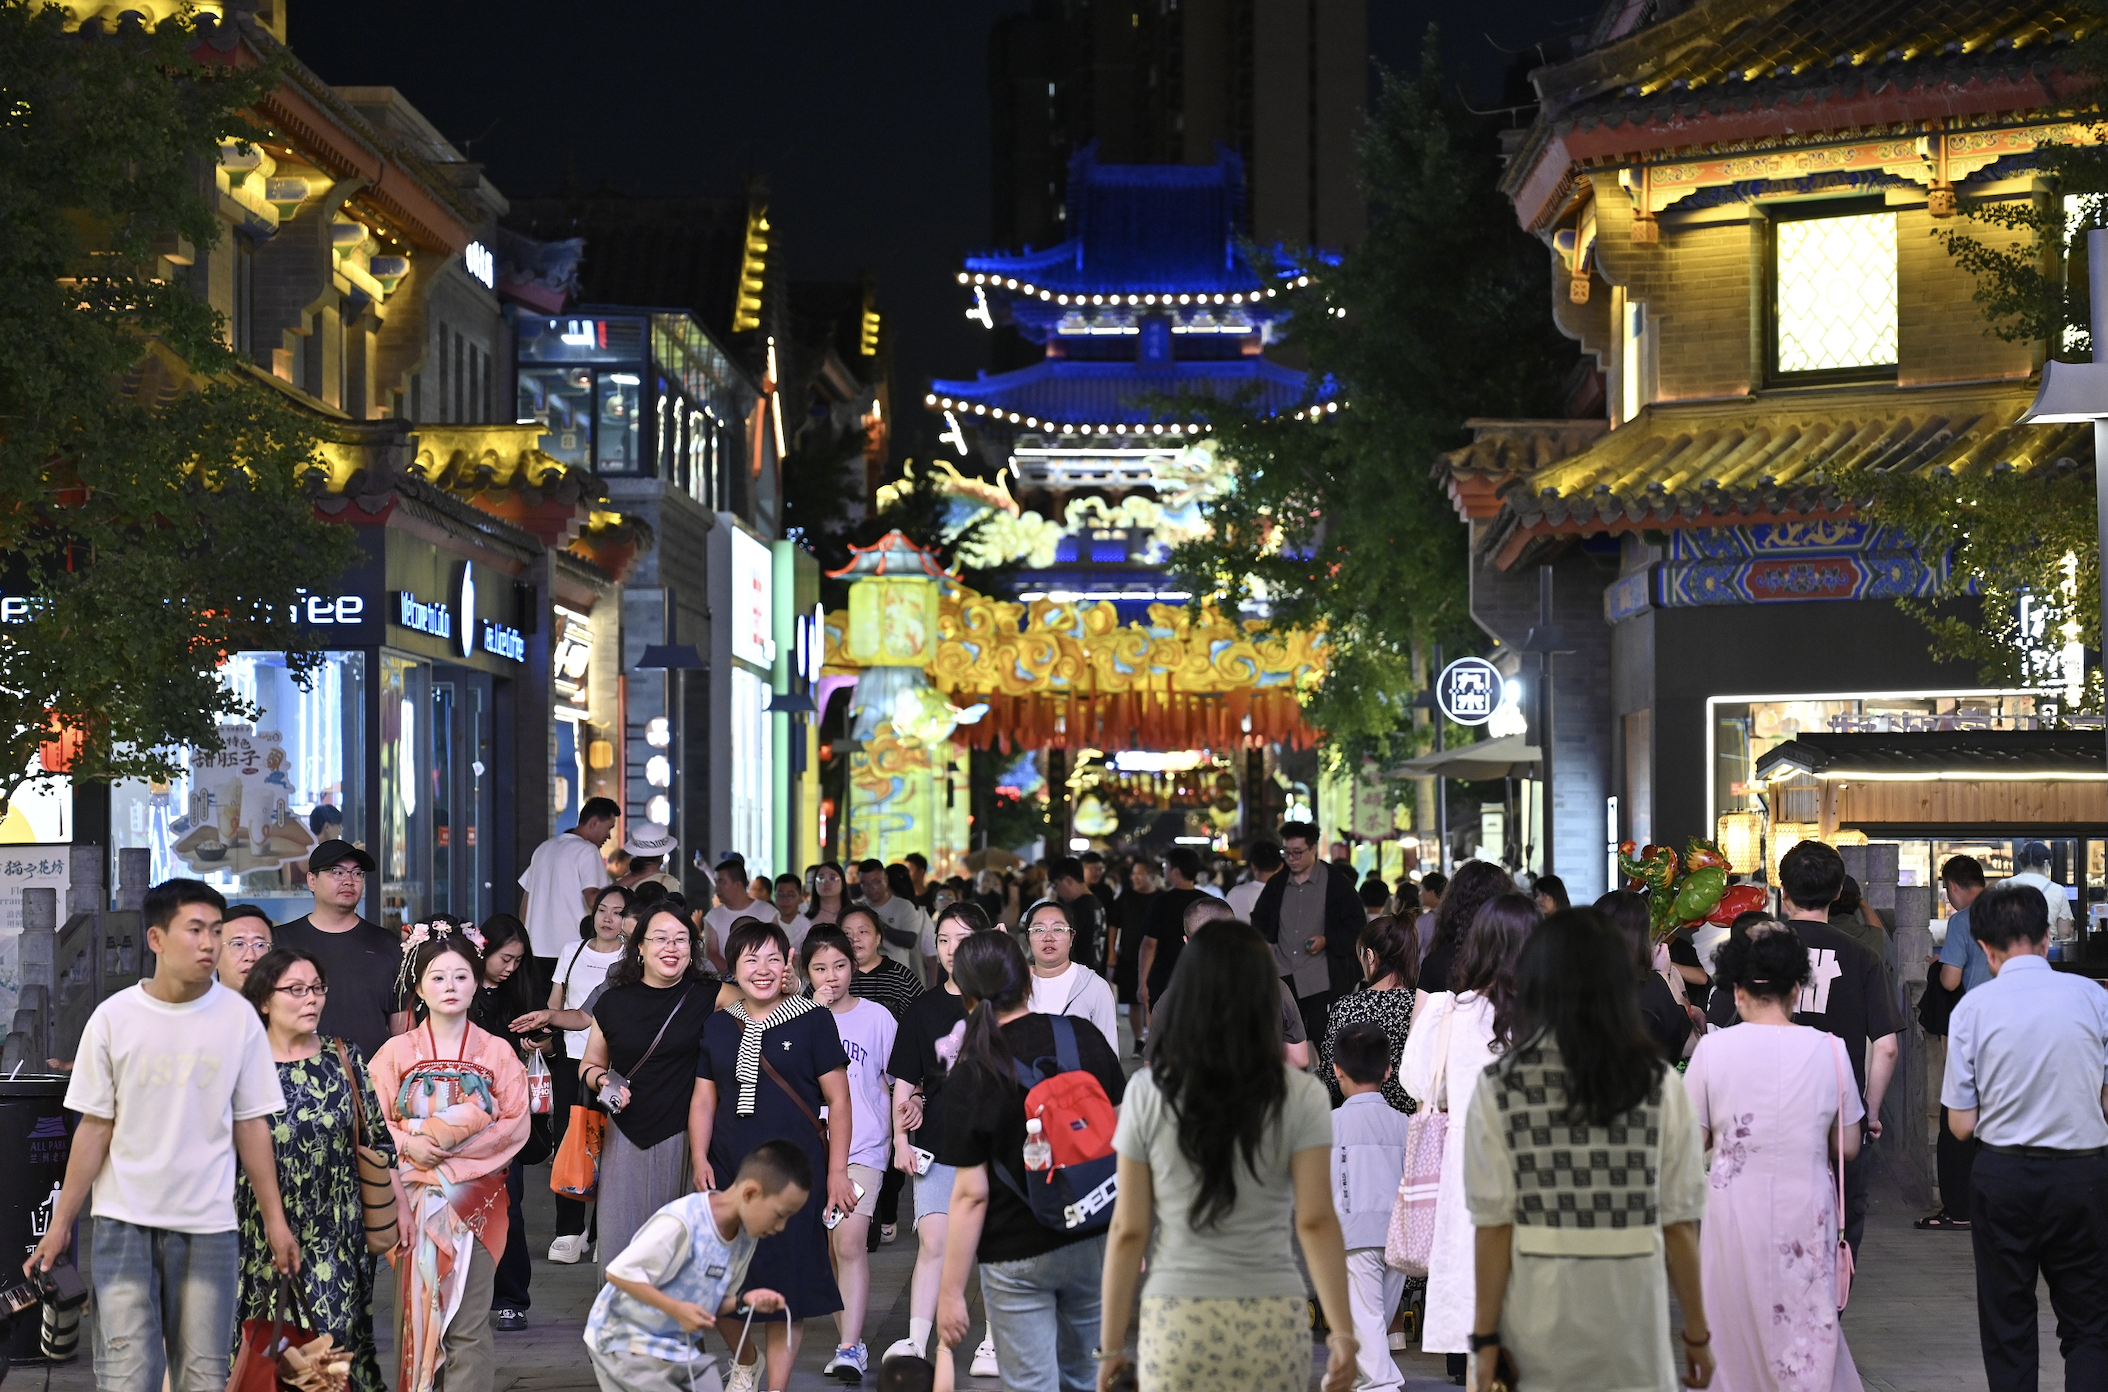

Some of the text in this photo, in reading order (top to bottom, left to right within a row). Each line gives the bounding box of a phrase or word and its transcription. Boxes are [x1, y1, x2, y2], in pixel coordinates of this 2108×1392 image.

[226, 734, 251, 750] 特色
[842, 1039, 868, 1067] ORT
[139, 1052, 222, 1089] 1977
[30, 1140, 67, 1152] ALL PARK
[1063, 1171, 1119, 1229] SPEC
